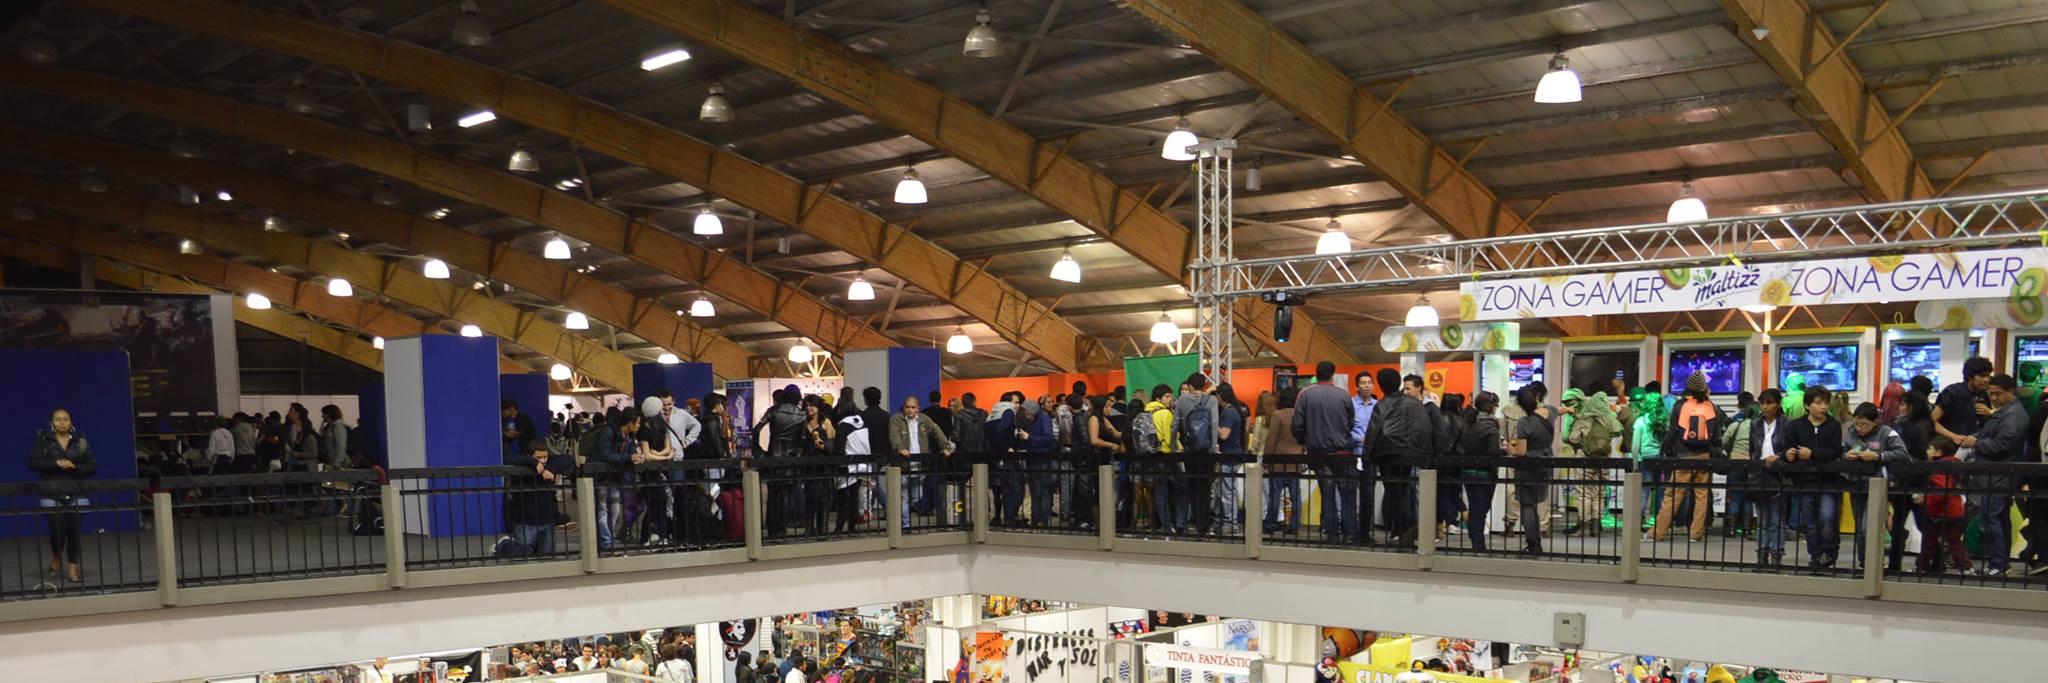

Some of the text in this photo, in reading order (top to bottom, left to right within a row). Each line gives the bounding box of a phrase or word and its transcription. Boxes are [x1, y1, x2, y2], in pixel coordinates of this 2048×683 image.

[1482, 276, 1667, 312] ZONA GAMER
[1693, 265, 1760, 303] maltizz
[1789, 256, 2023, 296] ZONA GAMER
[1070, 647, 1098, 666] SOL
[1167, 650, 1253, 668] TINTA FANTÁSTIC
